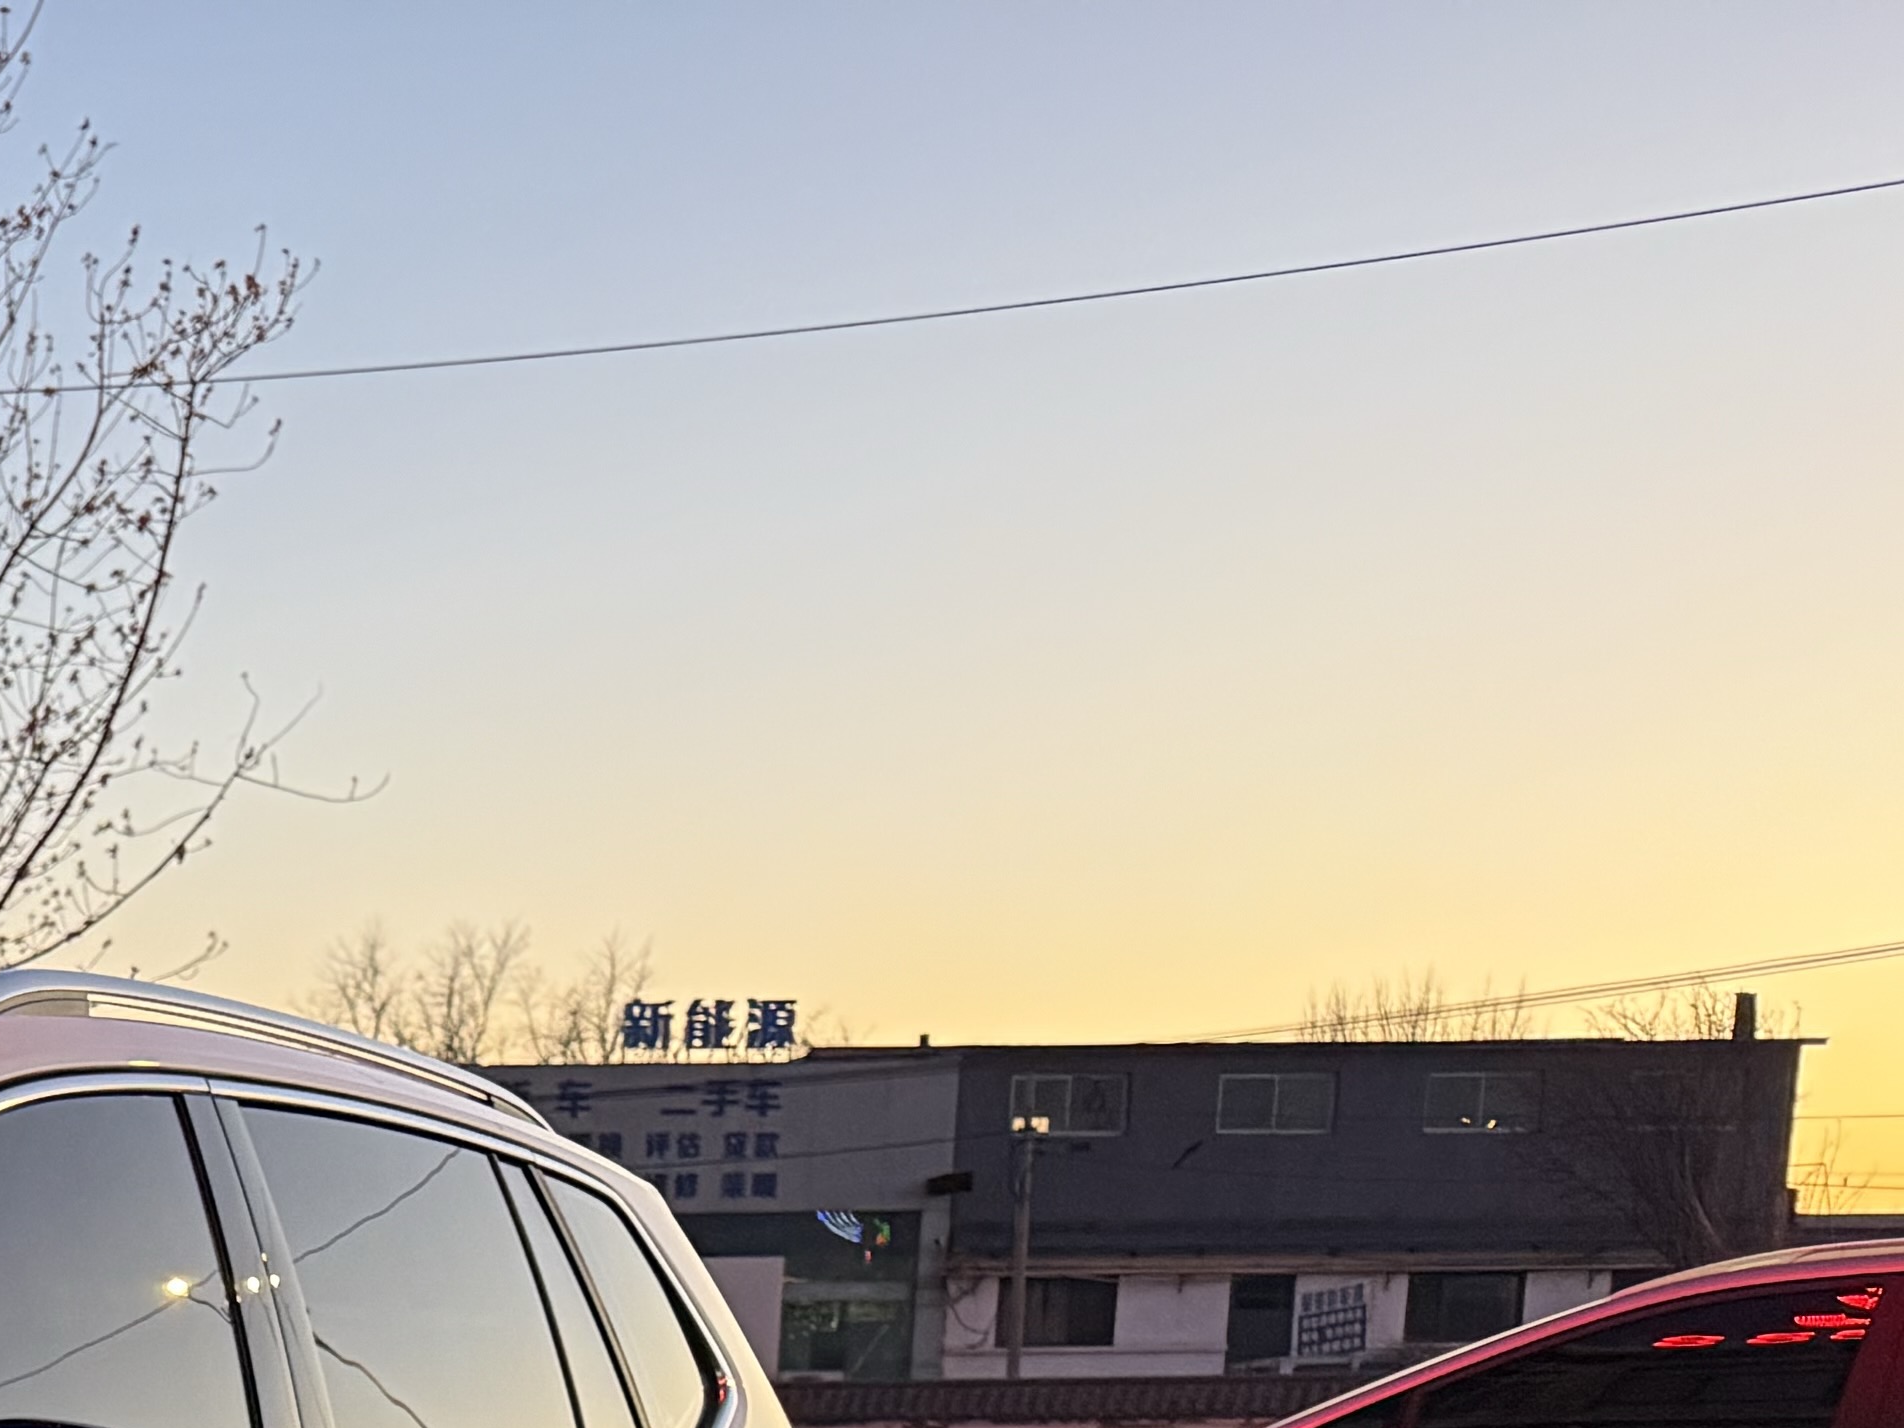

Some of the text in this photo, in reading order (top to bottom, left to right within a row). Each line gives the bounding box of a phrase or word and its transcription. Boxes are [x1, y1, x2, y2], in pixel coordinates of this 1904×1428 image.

[623, 999, 796, 1049] 新能源
[659, 1079, 783, 1118] 二手车
